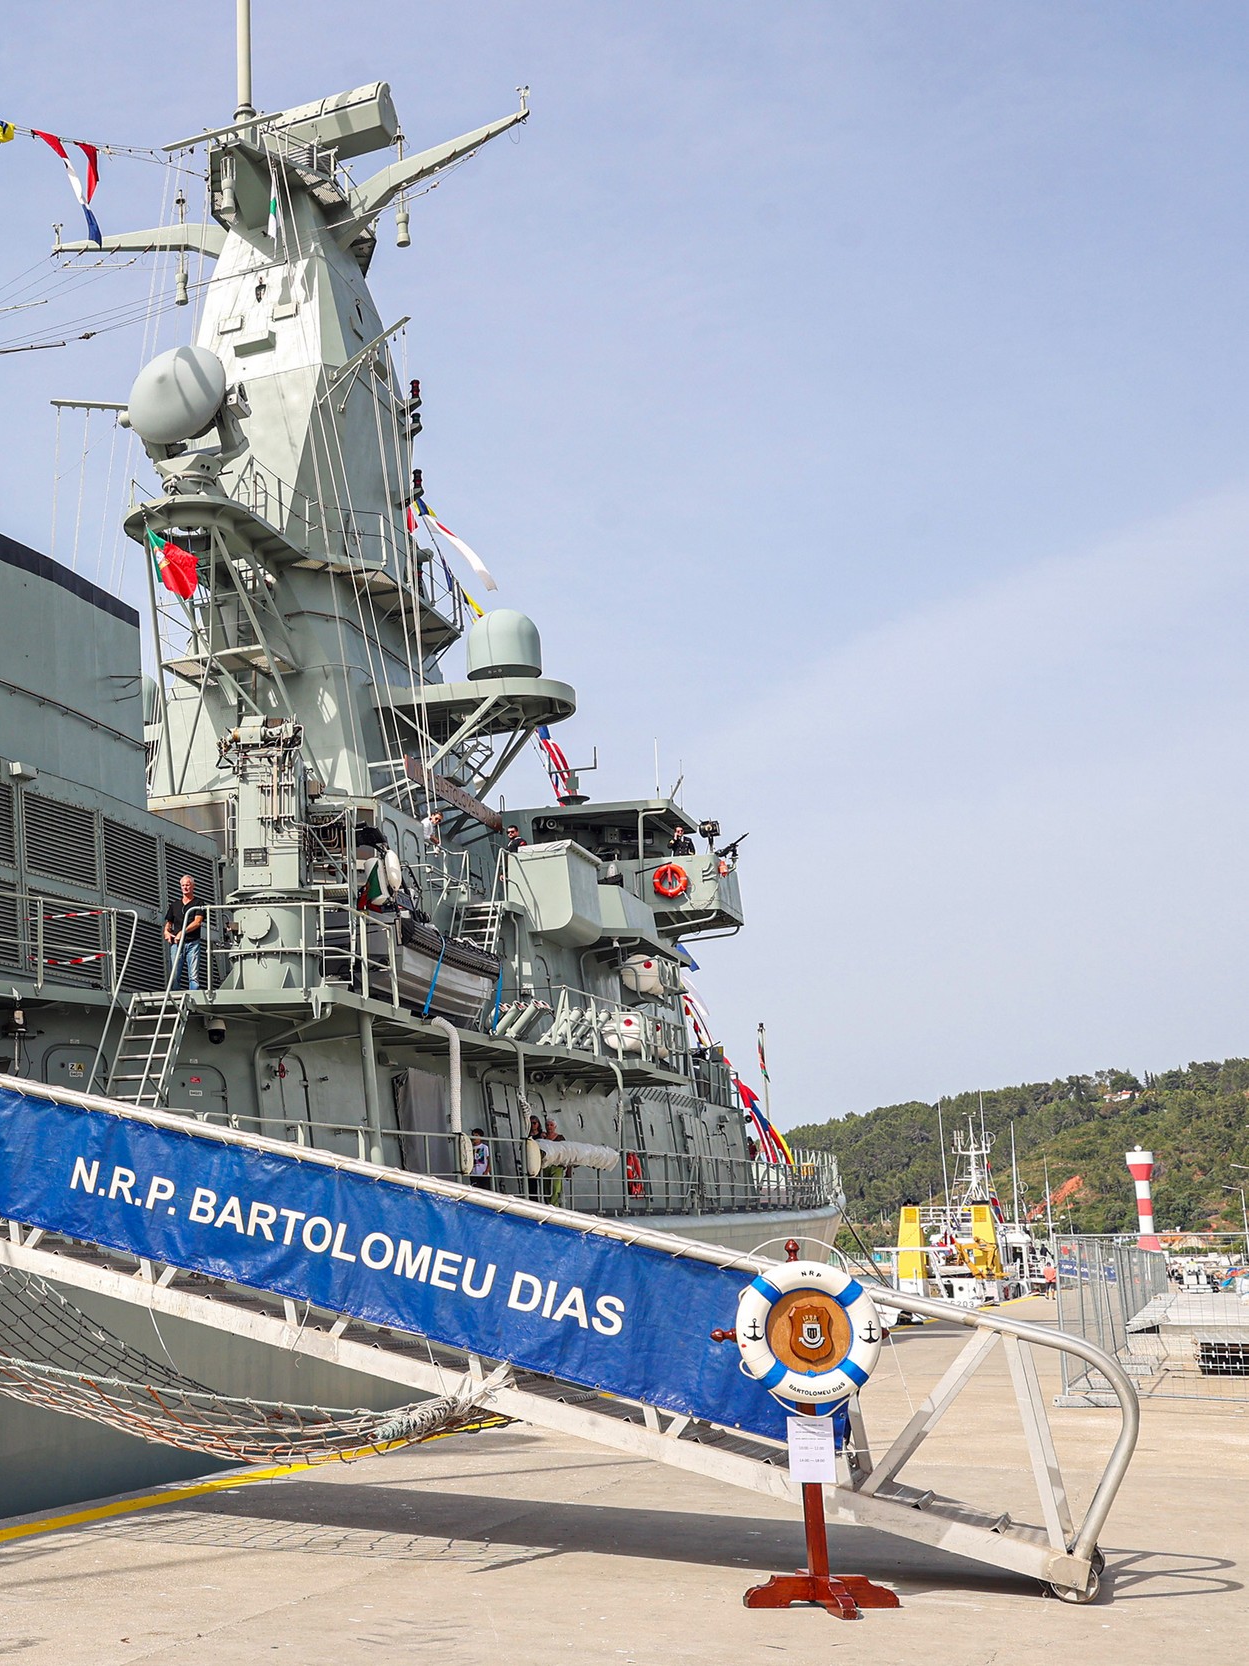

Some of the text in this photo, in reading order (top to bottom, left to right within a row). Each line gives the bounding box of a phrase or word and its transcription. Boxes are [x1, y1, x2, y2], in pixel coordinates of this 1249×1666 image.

[69, 1156, 625, 1336] N.R.P. BARTOLOMEU DIAS
[788, 1381, 846, 1397] BARTOLOMEU DIAS
